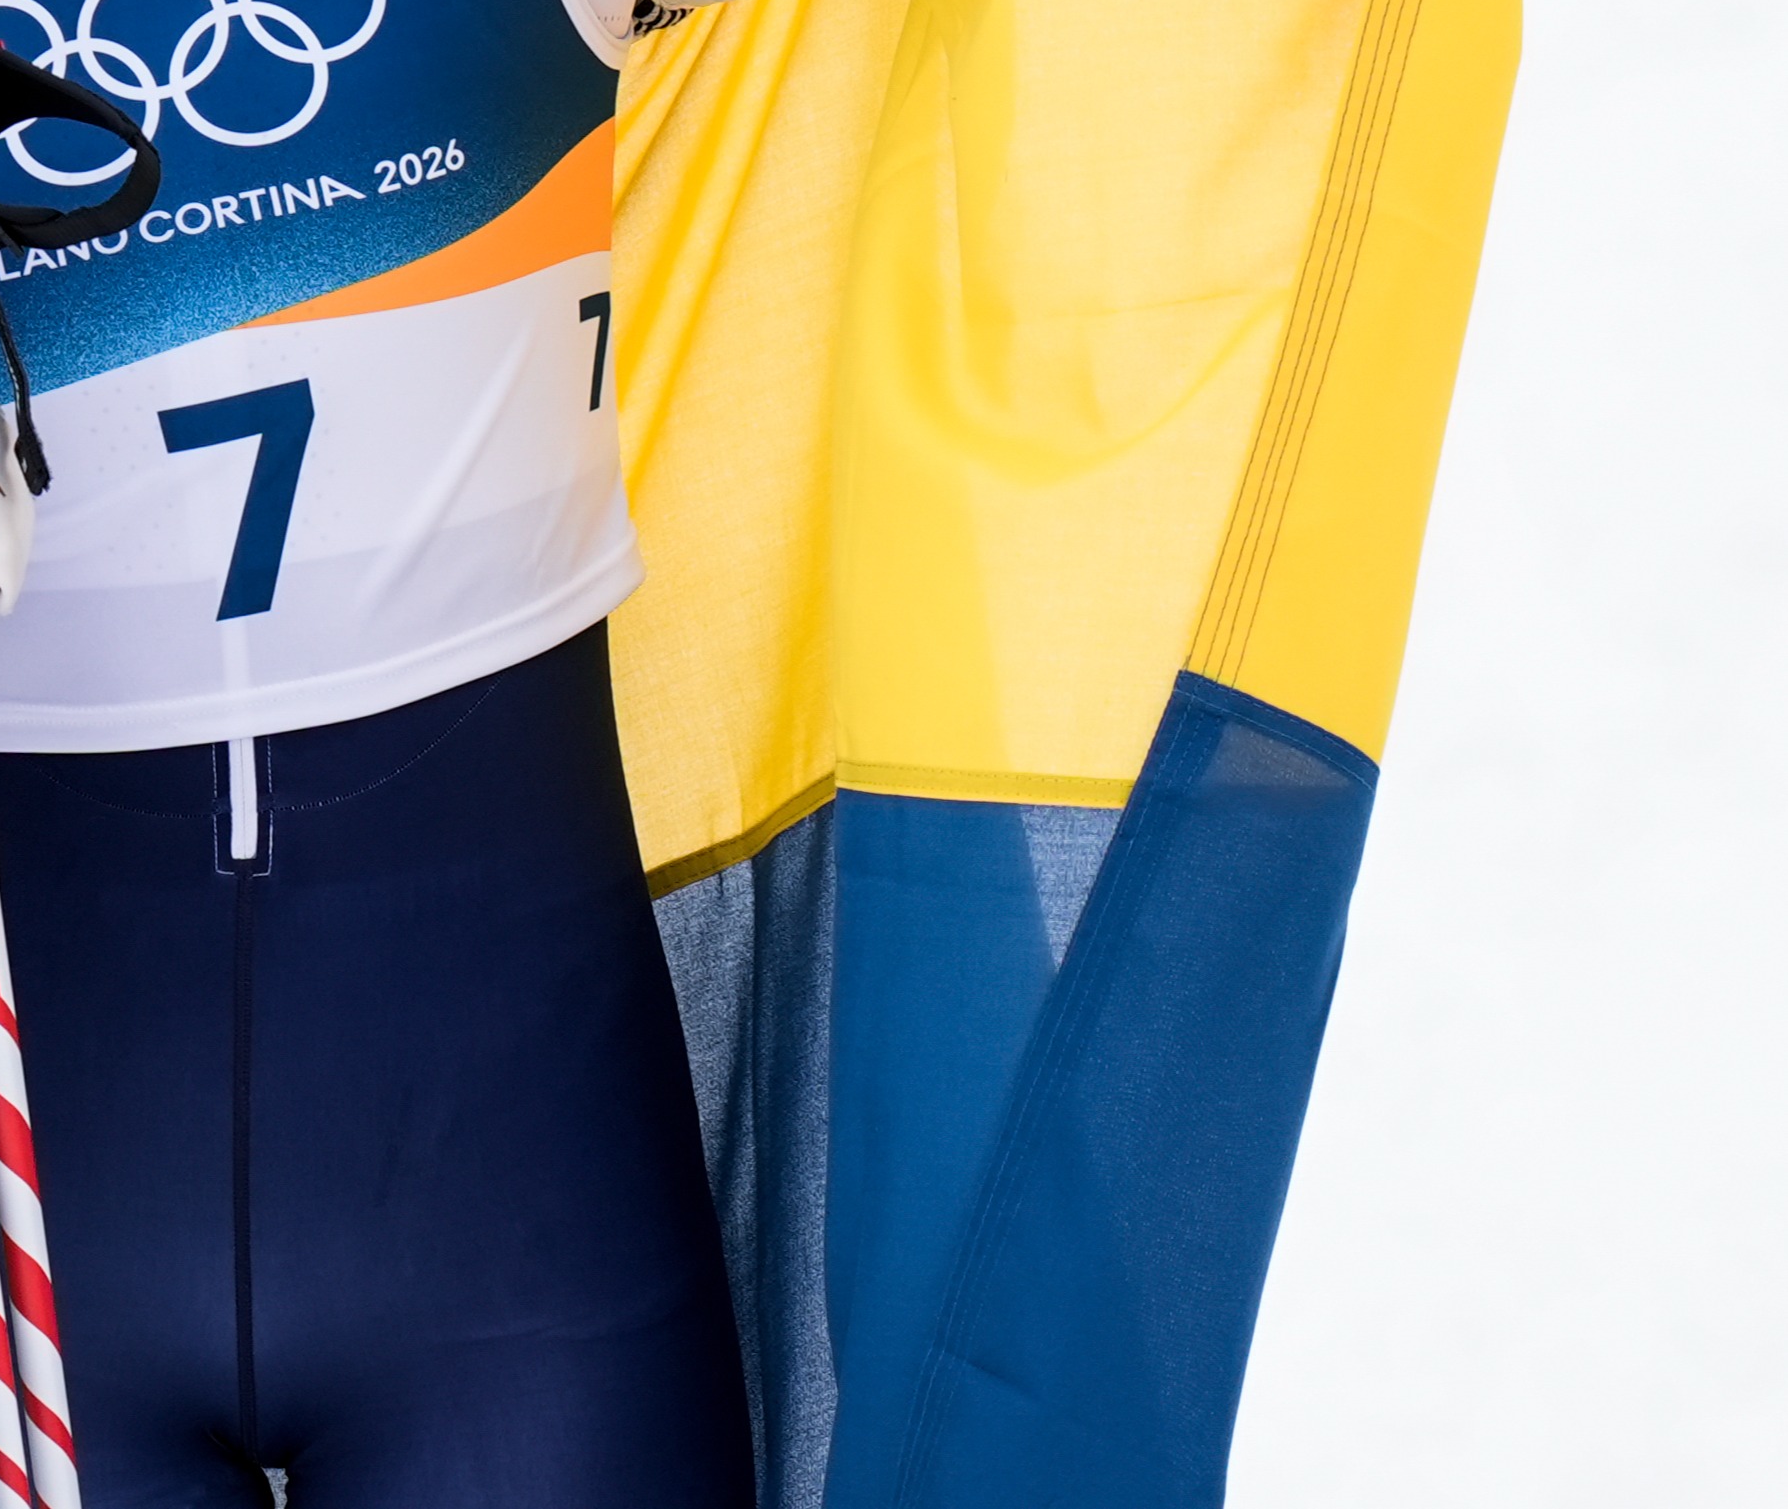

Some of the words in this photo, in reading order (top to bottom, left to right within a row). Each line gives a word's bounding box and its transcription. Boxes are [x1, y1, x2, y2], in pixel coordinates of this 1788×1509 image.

[139, 174, 367, 244] CORTINA
[374, 138, 466, 194] 2026
[579, 291, 611, 412] 7
[157, 378, 315, 622] 7
